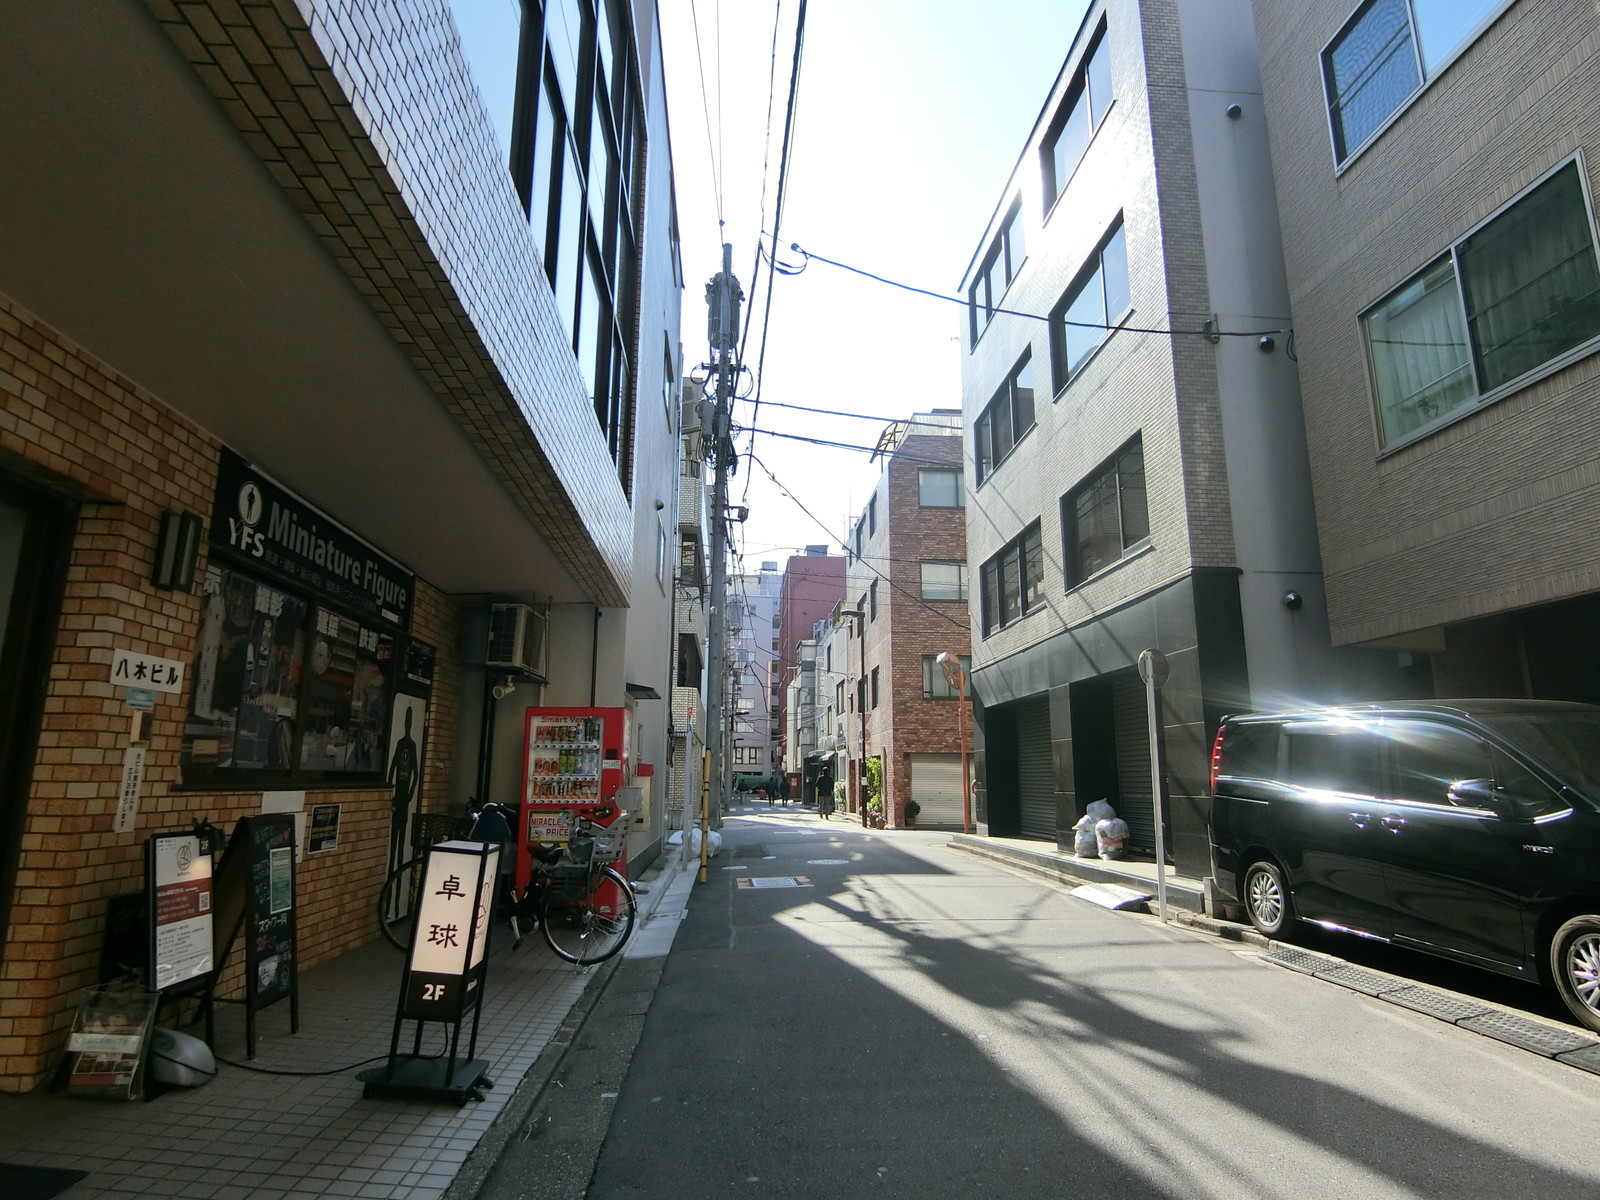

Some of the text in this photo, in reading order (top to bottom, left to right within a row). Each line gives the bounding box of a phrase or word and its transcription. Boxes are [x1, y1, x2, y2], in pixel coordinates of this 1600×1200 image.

[228, 517, 266, 558] YFS
[267, 501, 361, 585] Miniature
[364, 559, 407, 610] Figure
[115, 657, 180, 686] 八木ビル
[531, 817, 562, 826] MIRACLE
[546, 828, 569, 837] PRICE
[200, 840, 209, 850] 2F
[427, 874, 466, 949] 卓球
[422, 983, 446, 1001] 2F
